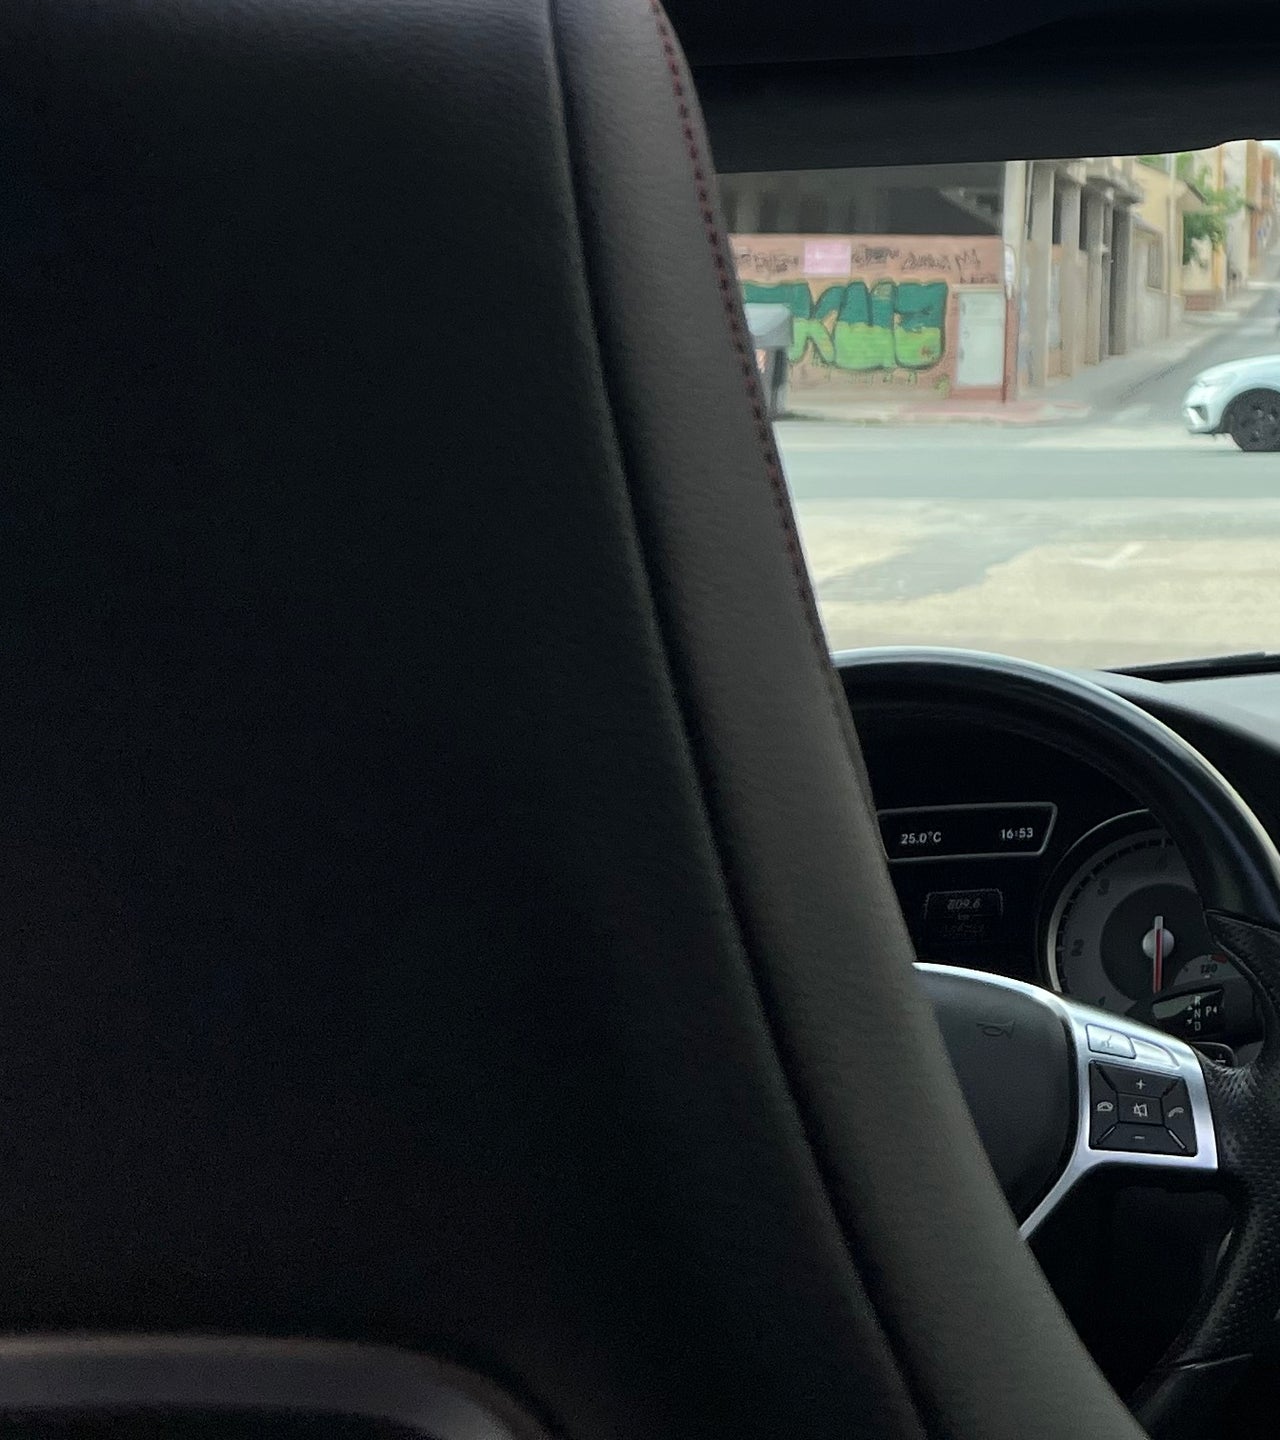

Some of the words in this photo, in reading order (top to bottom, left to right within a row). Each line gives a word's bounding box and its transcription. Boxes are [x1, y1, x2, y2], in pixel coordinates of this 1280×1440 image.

[900, 831, 942, 845] 25.0°C
[1000, 827, 1034, 841] 16:53
[1071, 938, 1084, 956] 2
